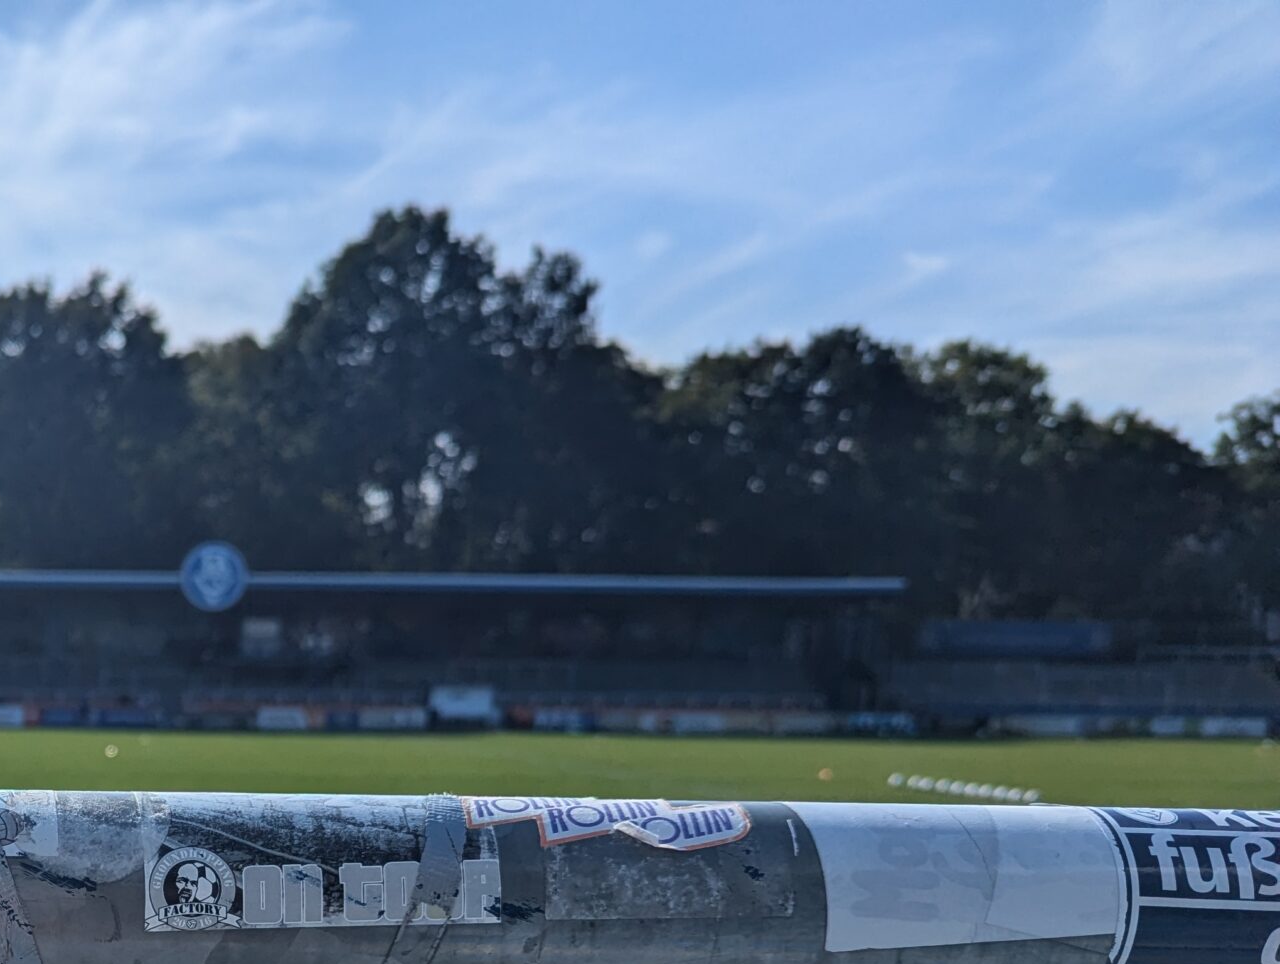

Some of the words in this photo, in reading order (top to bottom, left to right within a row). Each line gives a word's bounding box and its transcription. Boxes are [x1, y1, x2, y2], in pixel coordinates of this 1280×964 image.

[630, 806, 736, 844] OLLIN'
[152, 848, 234, 889] GROUNDHOPPING
[164, 903, 222, 917] FACTORY
